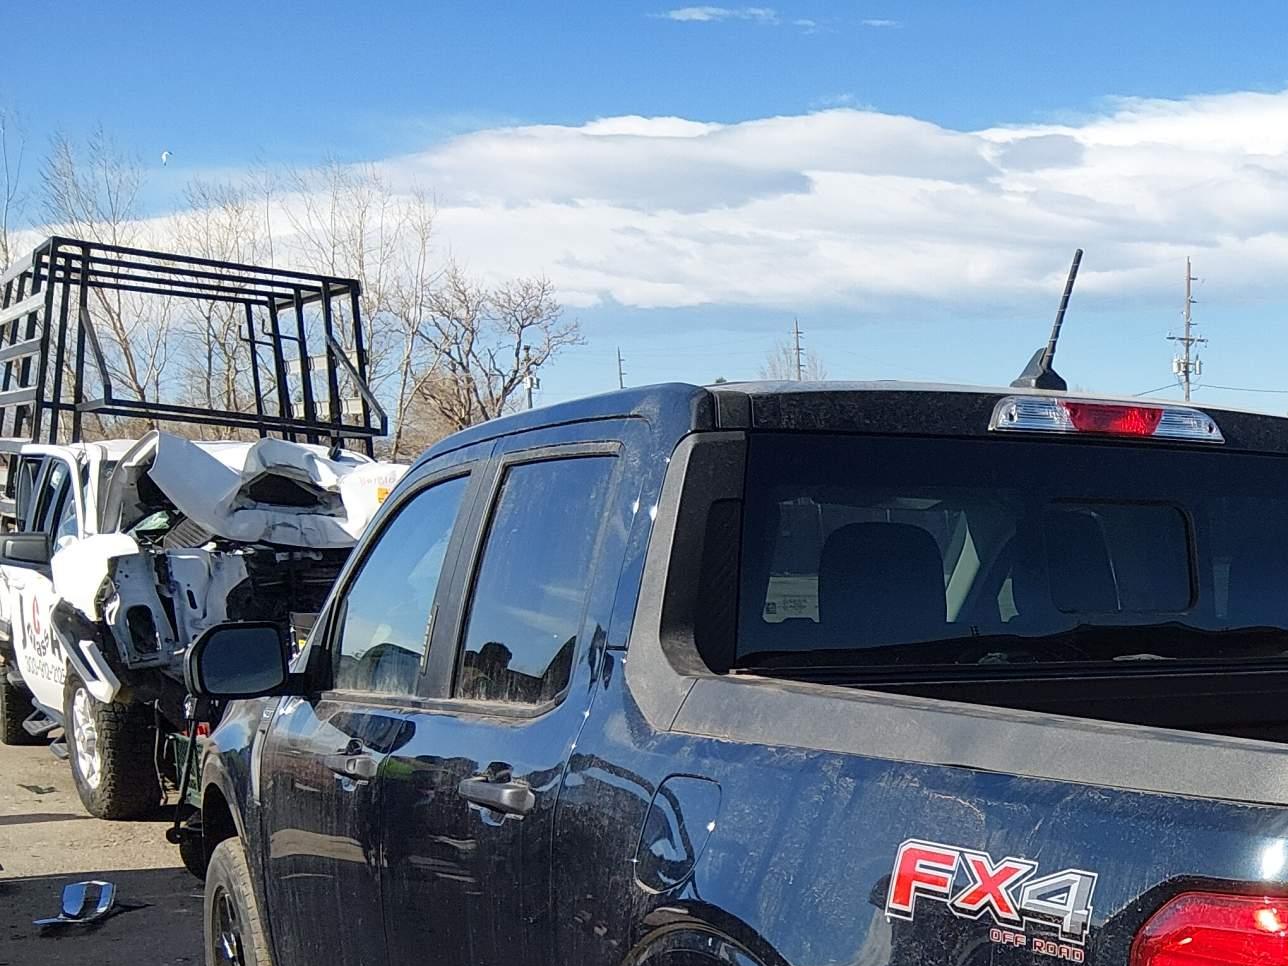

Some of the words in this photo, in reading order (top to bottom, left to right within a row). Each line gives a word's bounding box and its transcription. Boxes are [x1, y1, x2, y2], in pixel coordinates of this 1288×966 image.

[885, 838, 1098, 946] FX4
[989, 927, 1027, 948] OFF
[1032, 938, 1085, 963] ROAD
